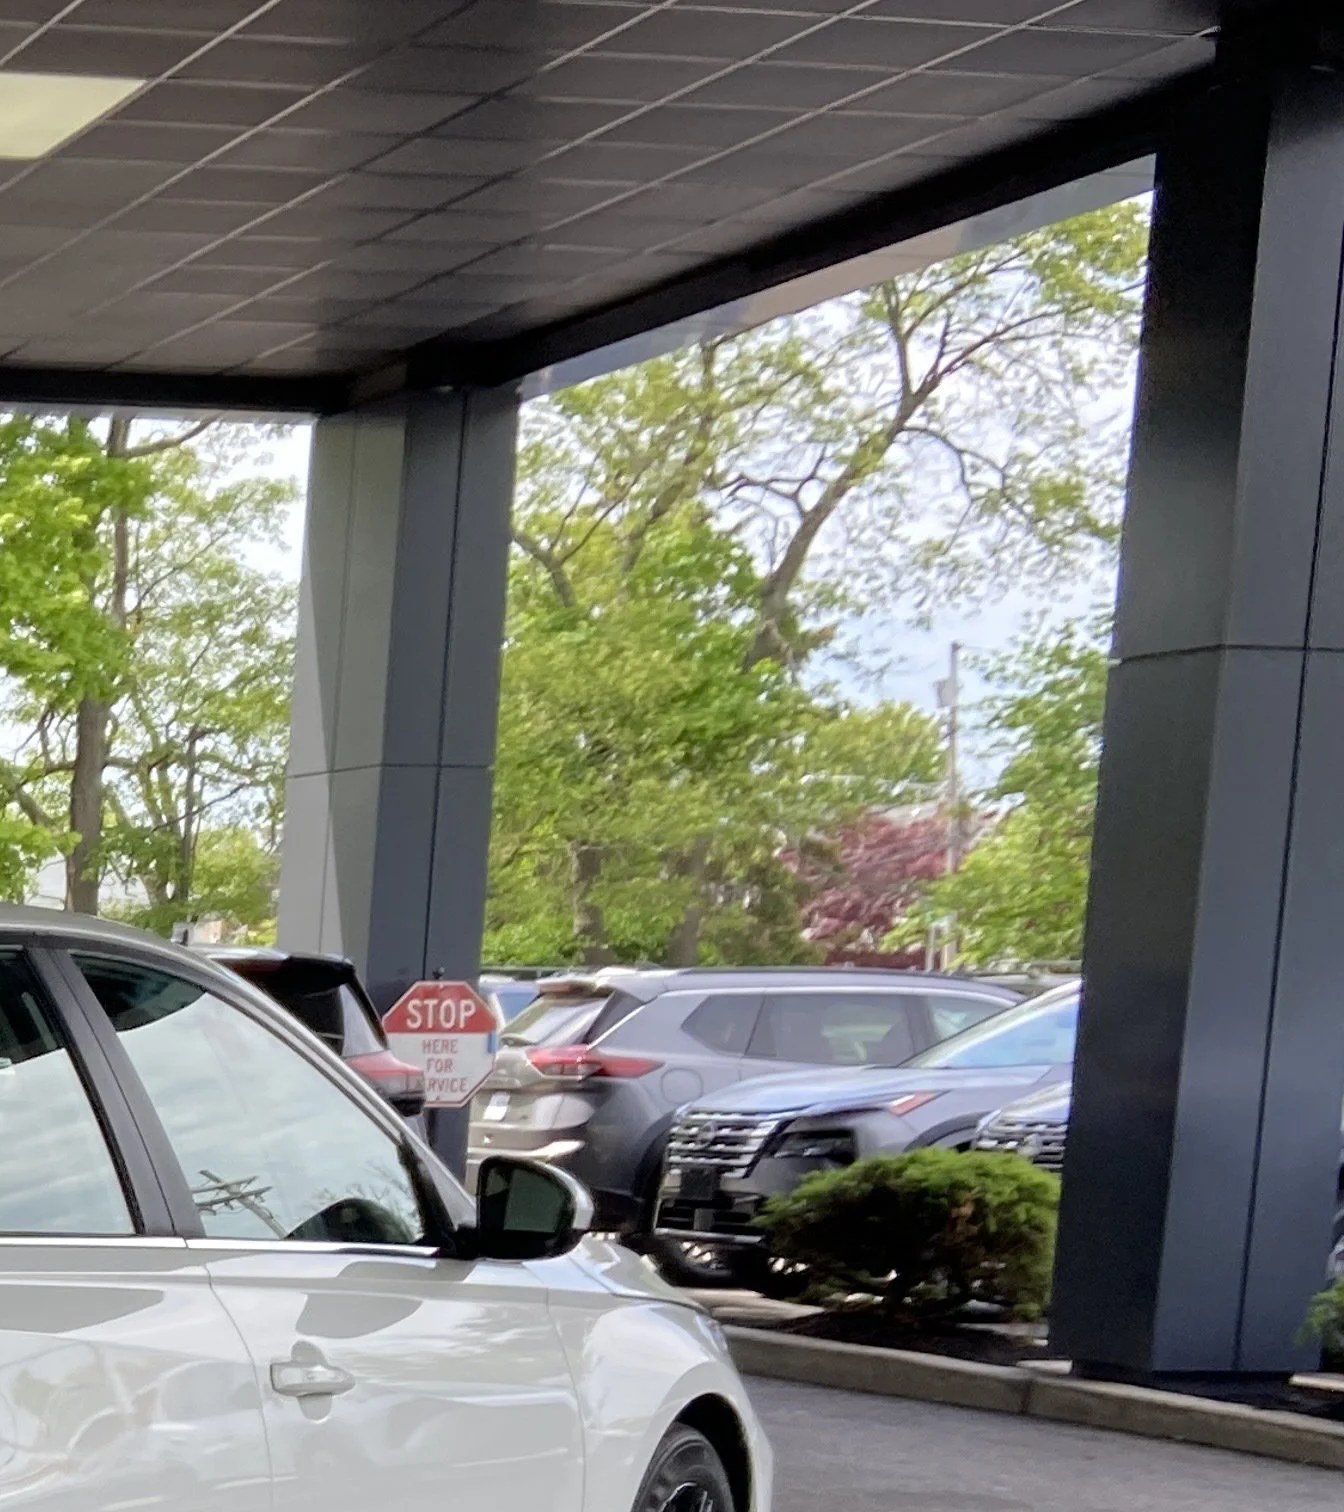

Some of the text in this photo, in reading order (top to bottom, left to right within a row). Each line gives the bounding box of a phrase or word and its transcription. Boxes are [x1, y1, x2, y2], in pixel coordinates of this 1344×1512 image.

[406, 999, 476, 1029] STOP
[422, 1039, 459, 1054] HERE
[426, 1058, 454, 1073] FOR
[425, 1077, 469, 1093] RVICE
